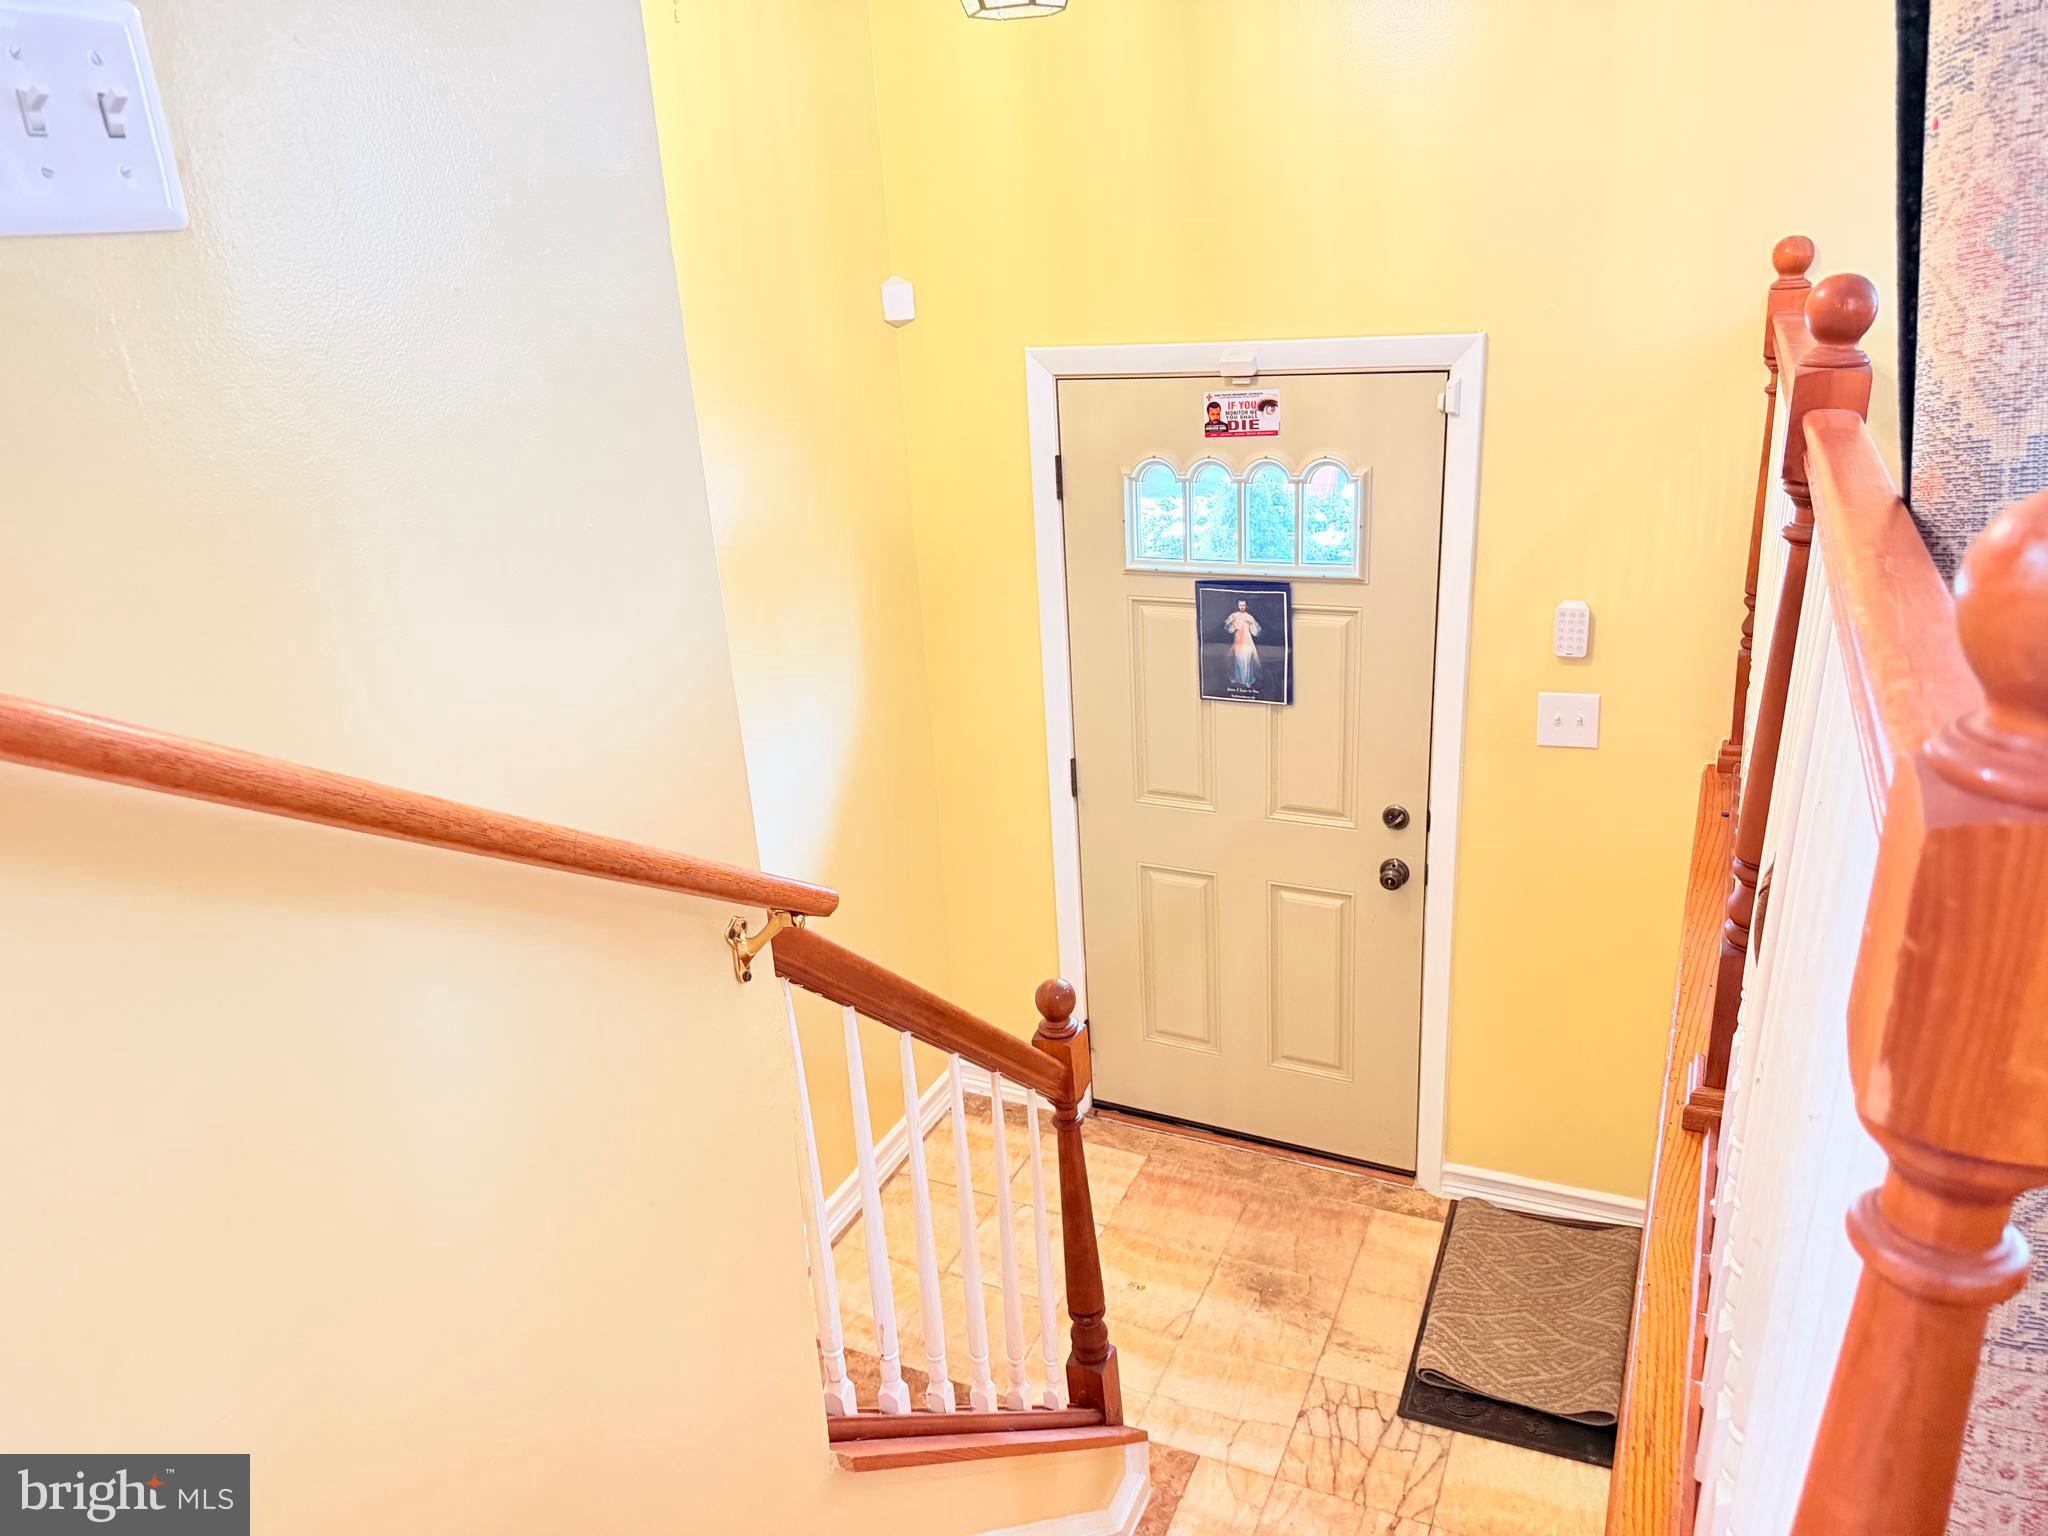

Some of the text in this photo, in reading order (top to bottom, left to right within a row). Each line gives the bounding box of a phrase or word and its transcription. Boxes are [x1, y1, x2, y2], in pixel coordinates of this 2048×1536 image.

[1228, 401, 1257, 410] IF YOU
[1228, 419, 1260, 431] DIE
